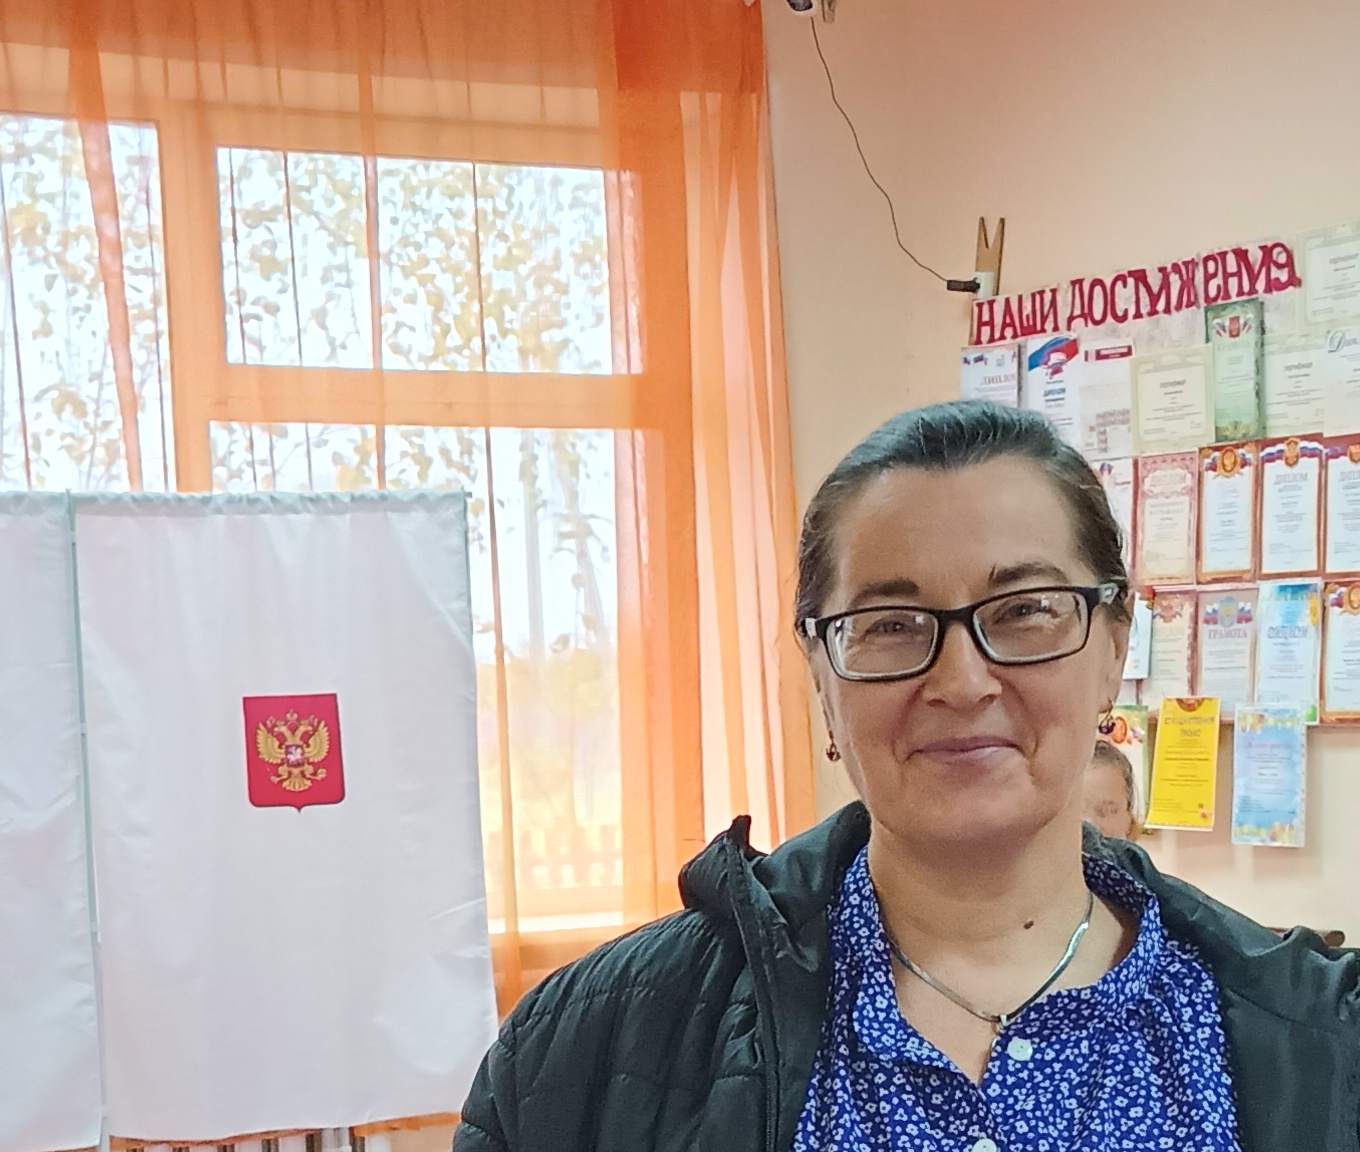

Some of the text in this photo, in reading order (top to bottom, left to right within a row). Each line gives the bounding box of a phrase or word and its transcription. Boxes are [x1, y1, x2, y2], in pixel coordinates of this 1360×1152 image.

[973, 287, 1060, 345] НАШИ
[1066, 242, 1302, 331] ДОСТИЖЕНИЯ
[1208, 628, 1248, 640] ГРАМОТА
